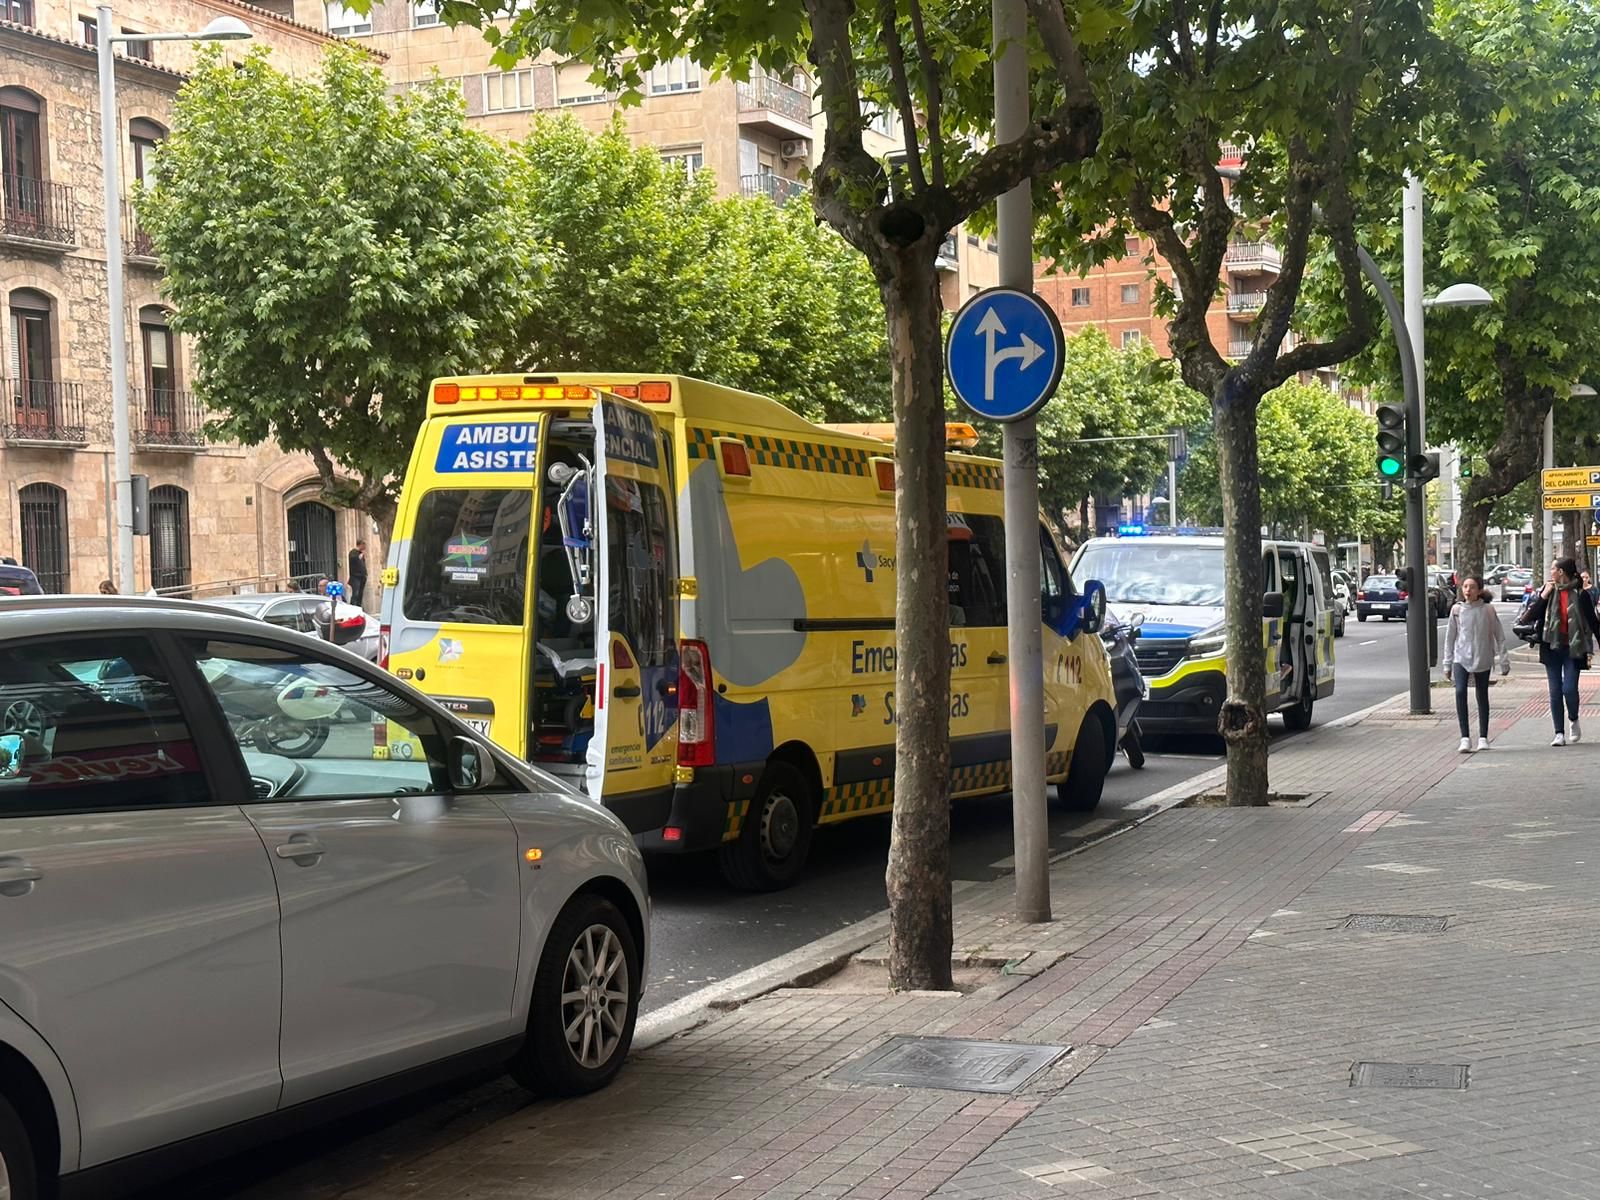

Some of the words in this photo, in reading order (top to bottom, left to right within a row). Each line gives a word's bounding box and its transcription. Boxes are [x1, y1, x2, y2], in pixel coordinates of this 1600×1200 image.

[604, 406, 649, 435] ANCIA
[456, 425, 537, 445] AMBUL
[1557, 479, 1588, 487] CAMPILLO
[1545, 496, 1576, 504] Monroy
[439, 702, 468, 711] STER
